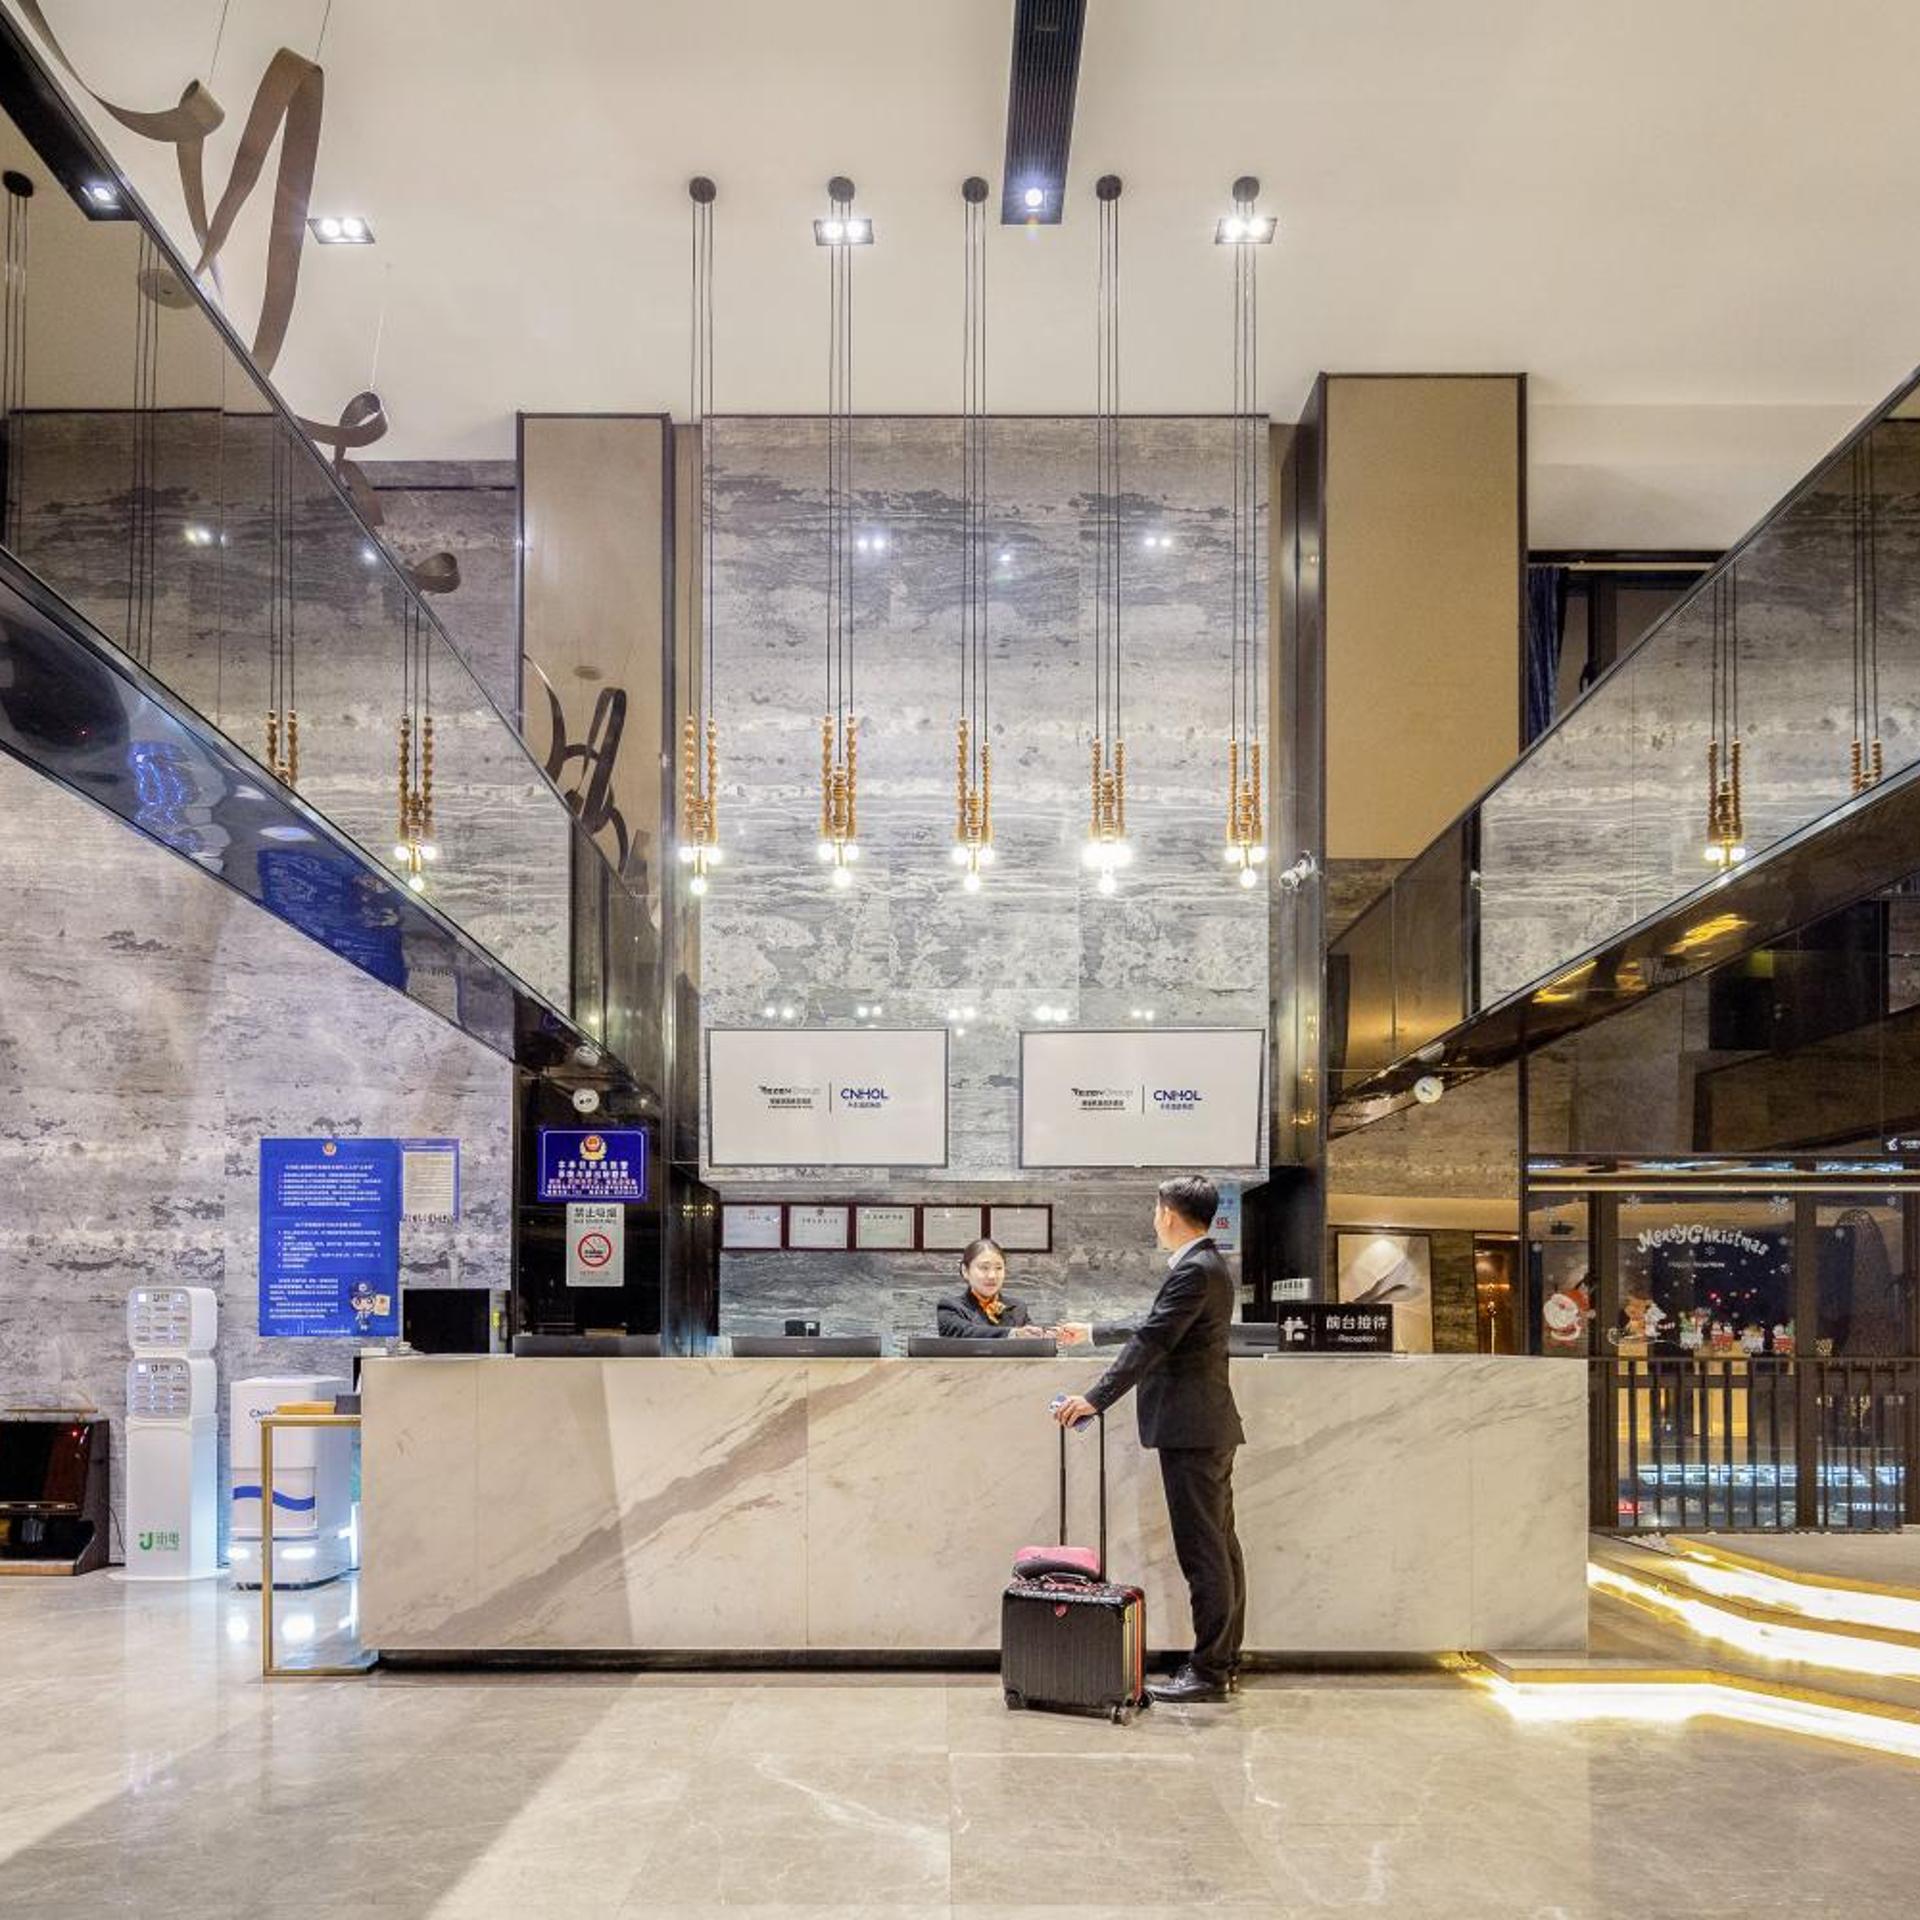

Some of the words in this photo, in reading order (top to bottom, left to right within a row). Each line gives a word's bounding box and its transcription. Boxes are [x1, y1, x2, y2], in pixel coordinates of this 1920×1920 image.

[1325, 1314, 1387, 1330] 前台接待
[1338, 1334, 1378, 1343] Reception
